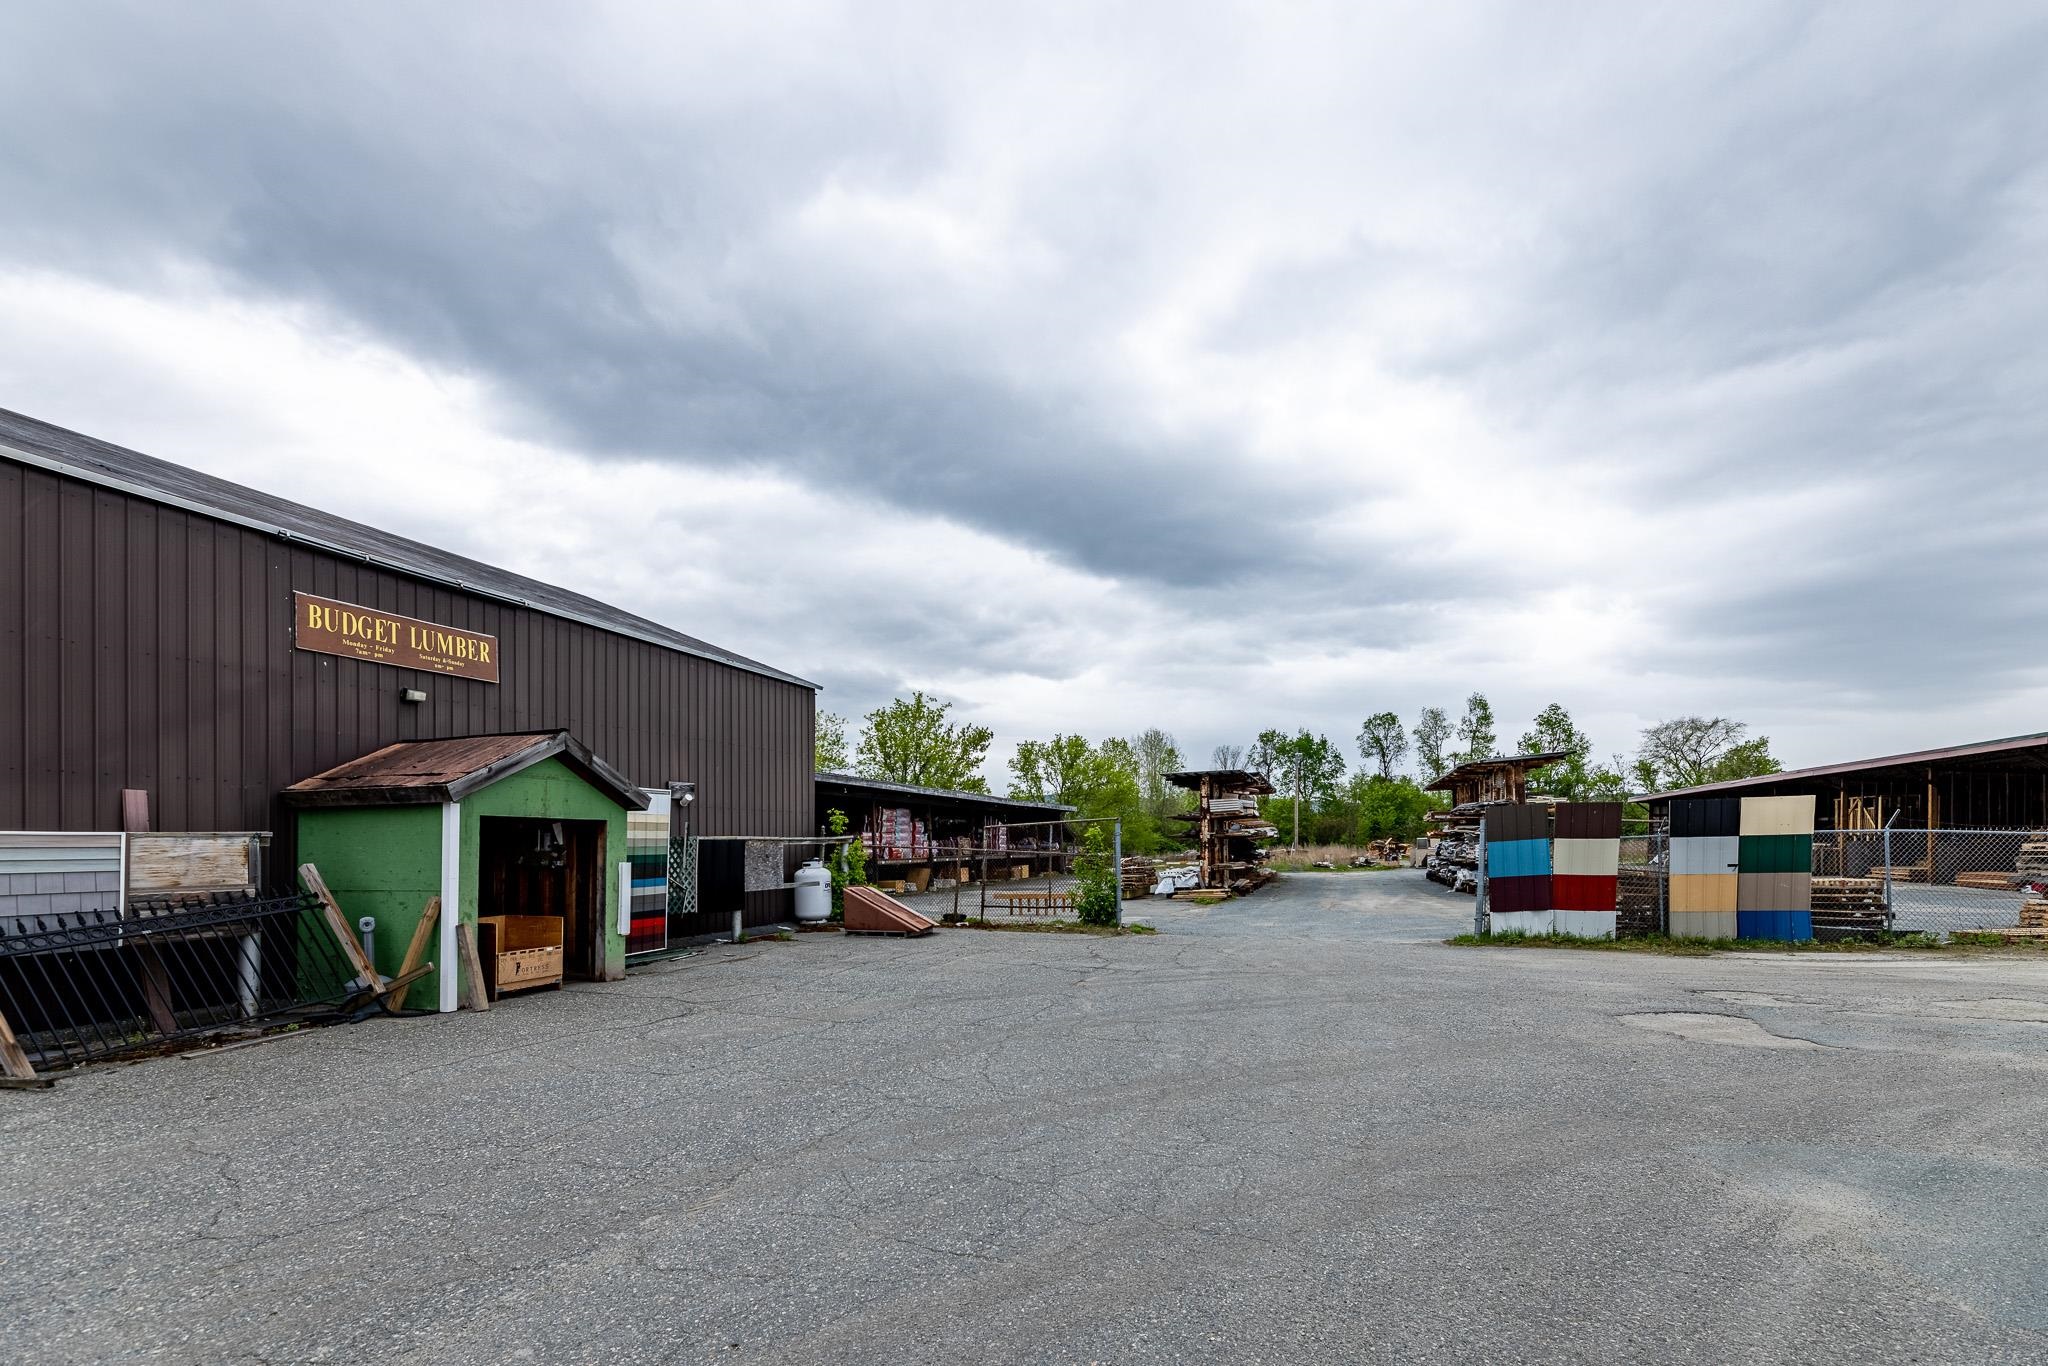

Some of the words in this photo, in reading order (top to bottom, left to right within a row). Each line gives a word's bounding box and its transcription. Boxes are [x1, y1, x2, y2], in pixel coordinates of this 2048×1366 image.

[307, 603, 401, 645] BUDGET
[409, 625, 491, 664] LUMBER
[342, 639, 368, 650] Monday
[375, 644, 396, 655] Friday
[419, 653, 441, 664] Saturday
[447, 658, 466, 668] Sunday
